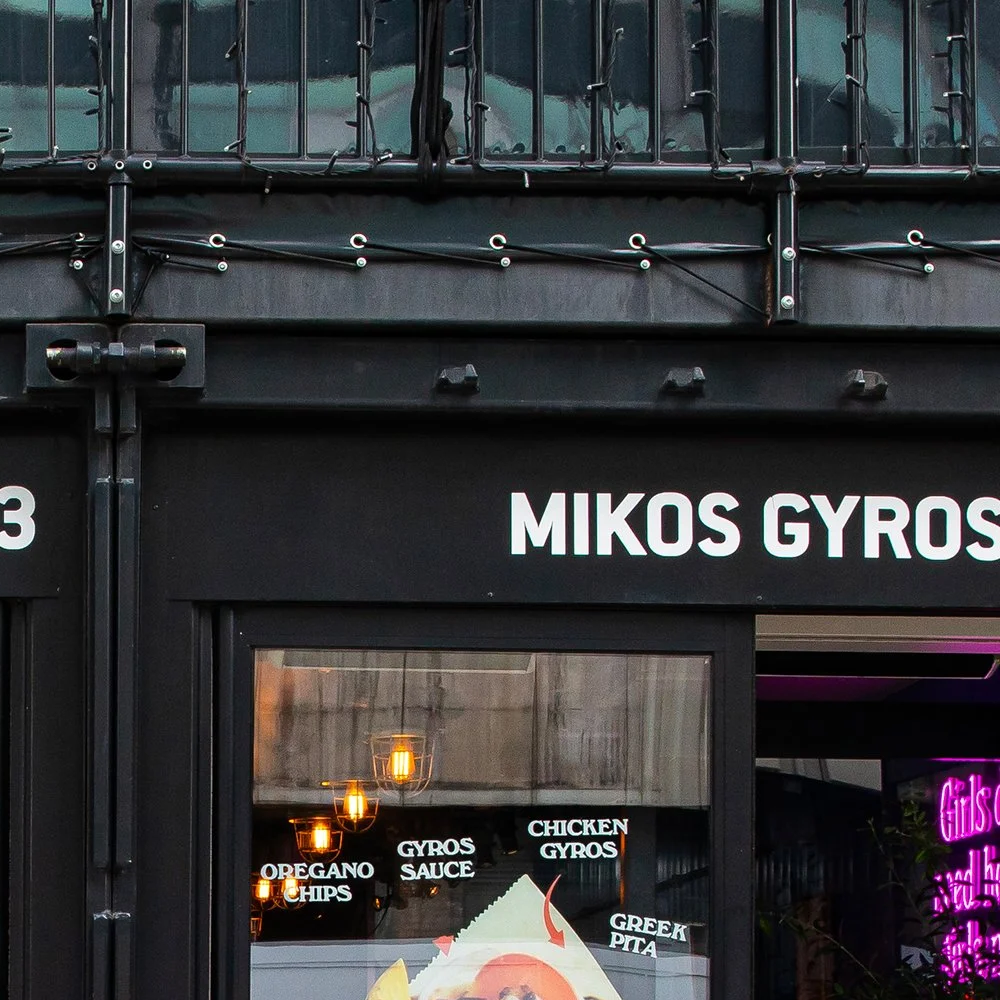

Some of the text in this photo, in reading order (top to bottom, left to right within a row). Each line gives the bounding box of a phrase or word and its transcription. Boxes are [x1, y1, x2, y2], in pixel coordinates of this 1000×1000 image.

[510, 491, 1000, 561] MIKOS GYROS
[527, 818, 628, 837] CHICKEN
[397, 837, 475, 858] GYROS
[540, 841, 618, 860] GYROS
[260, 862, 375, 880] OREGANO
[400, 860, 475, 881] SAUCE
[283, 884, 352, 902] CHIPS
[609, 913, 687, 942] GREEK
[609, 931, 657, 959] PITA
